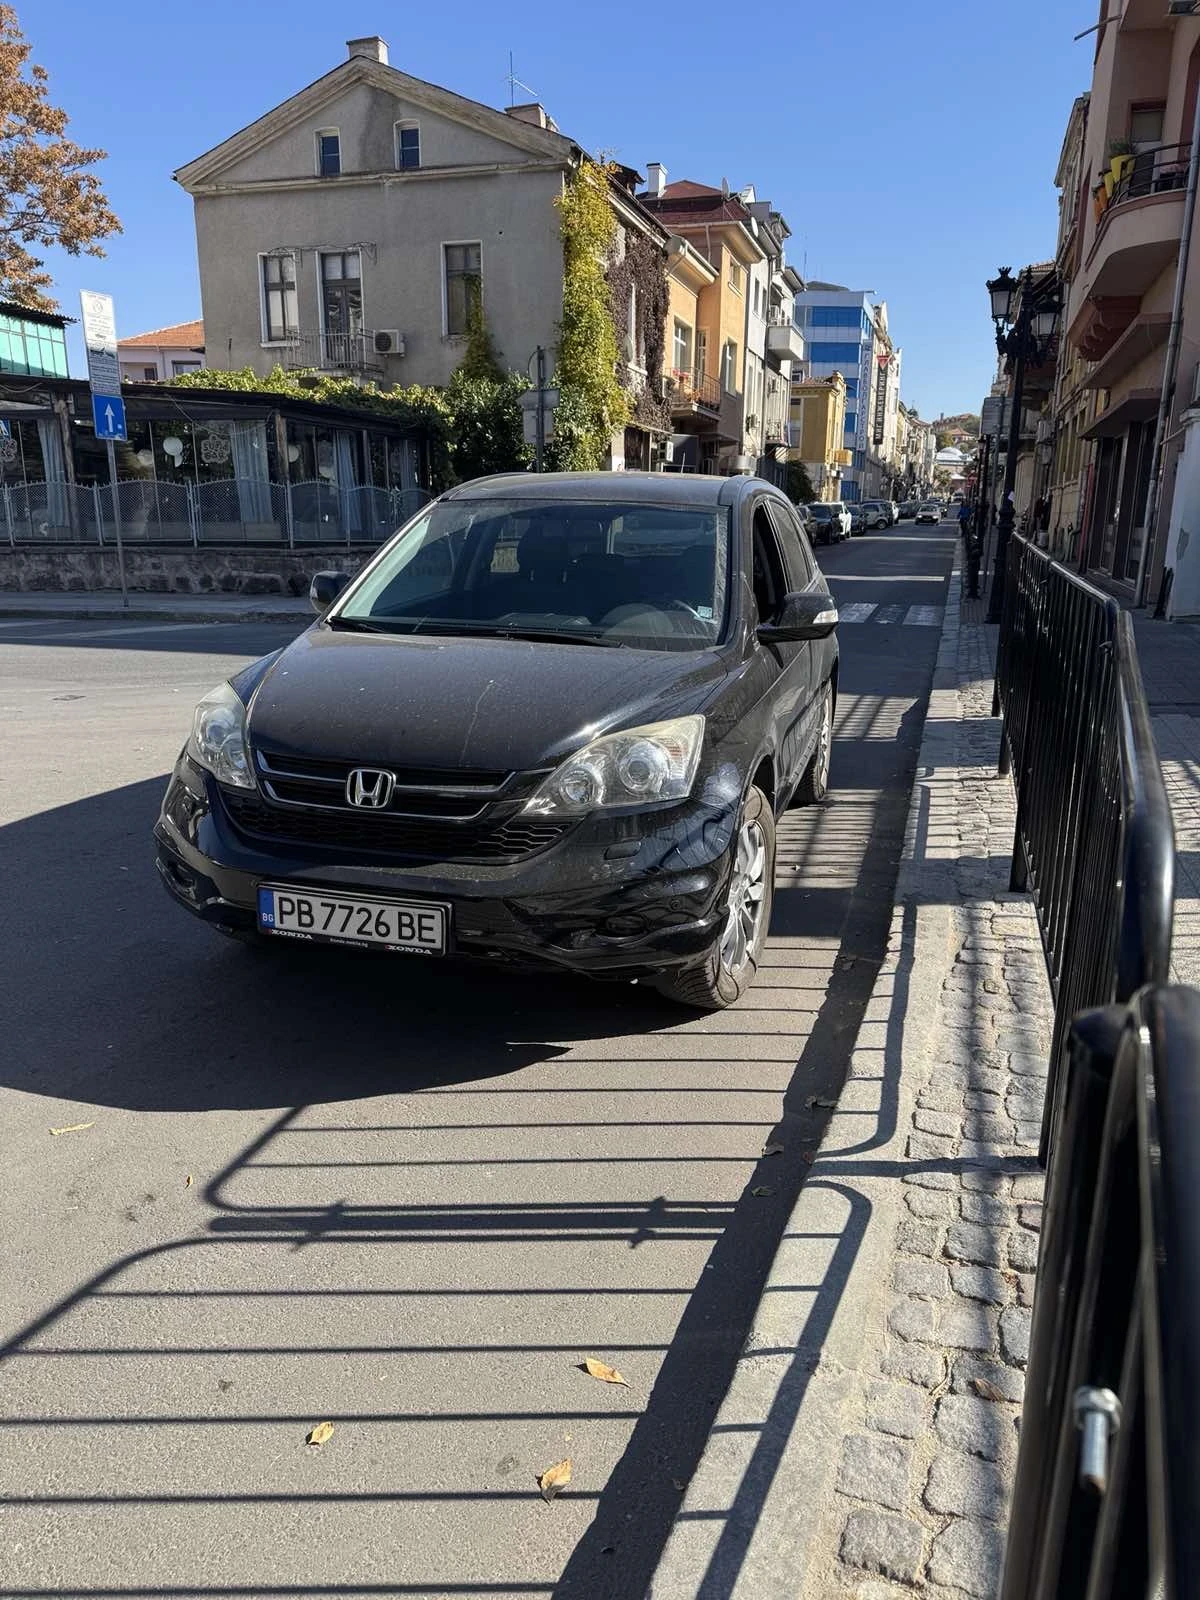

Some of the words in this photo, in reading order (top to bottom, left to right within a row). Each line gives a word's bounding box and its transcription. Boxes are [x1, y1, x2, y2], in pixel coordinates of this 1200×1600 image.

[262, 912, 274, 922] BG
[278, 896, 315, 928] PB
[320, 902, 391, 938] 7726
[397, 911, 436, 944] BE
